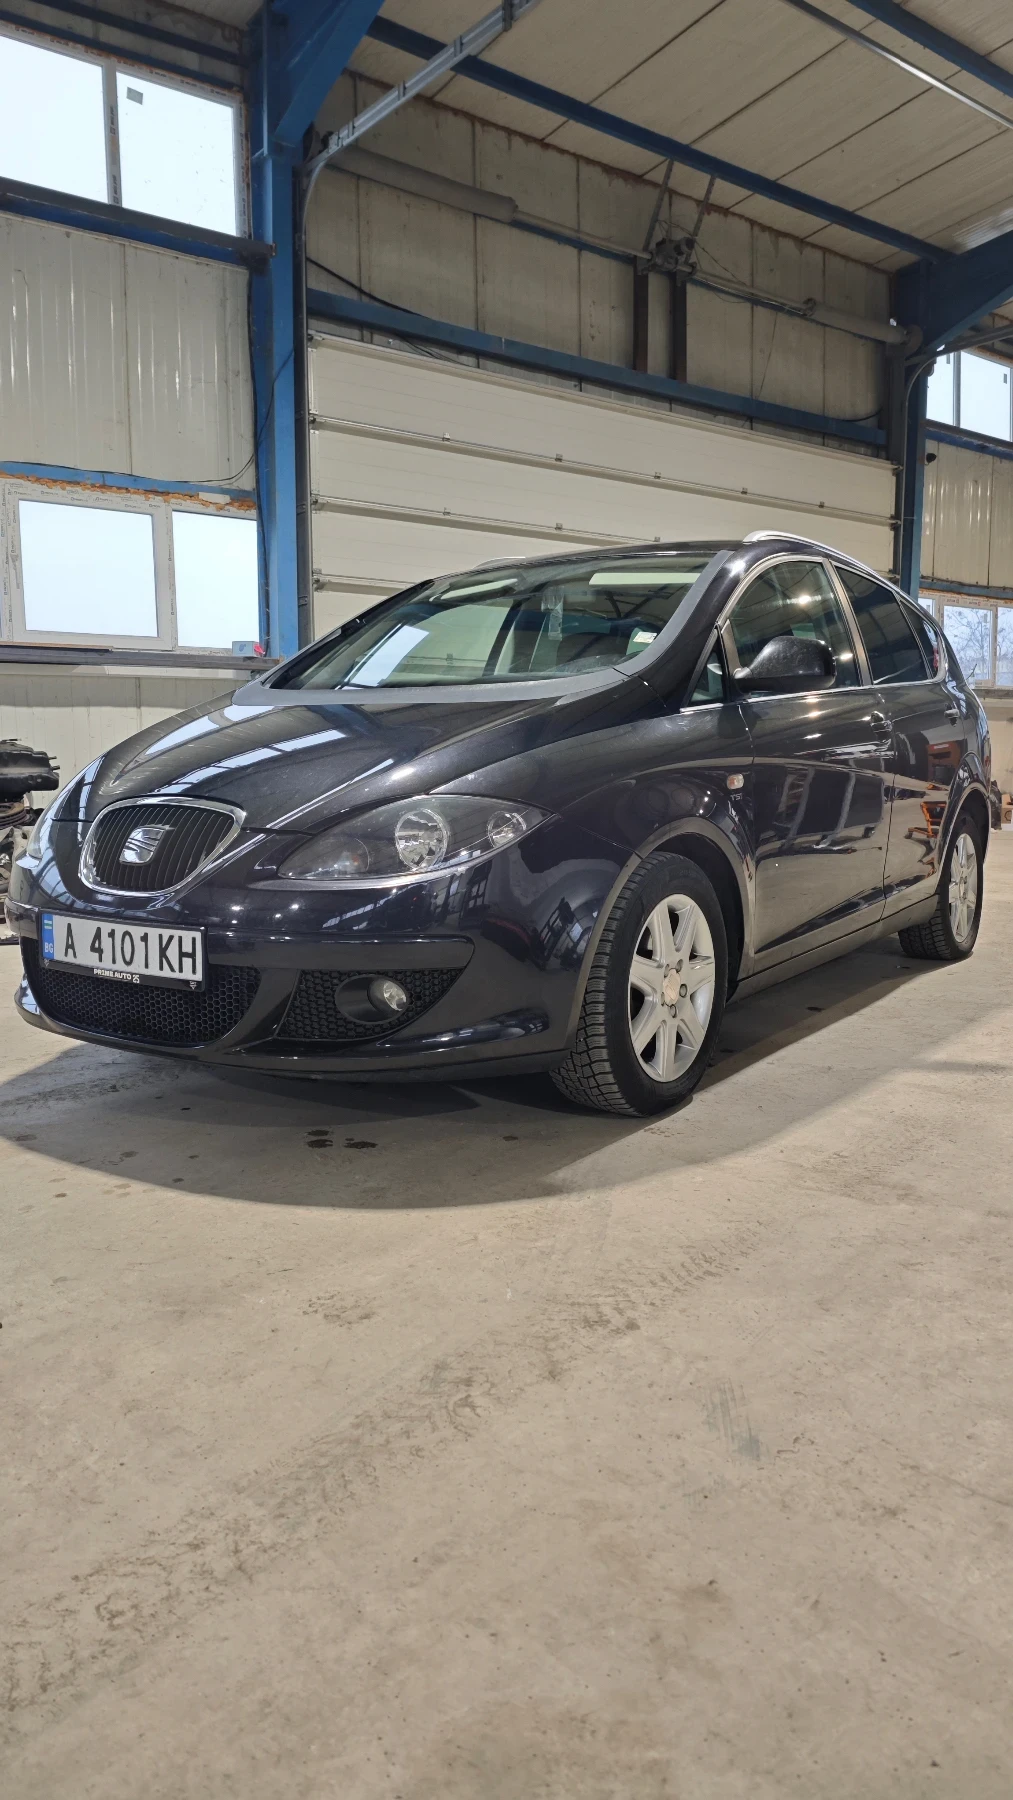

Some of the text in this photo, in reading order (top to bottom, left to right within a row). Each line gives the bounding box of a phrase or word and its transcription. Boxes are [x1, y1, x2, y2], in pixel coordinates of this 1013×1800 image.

[64, 922, 77, 959] A
[44, 942, 54, 953] BG
[114, 971, 132, 980] AUTO
